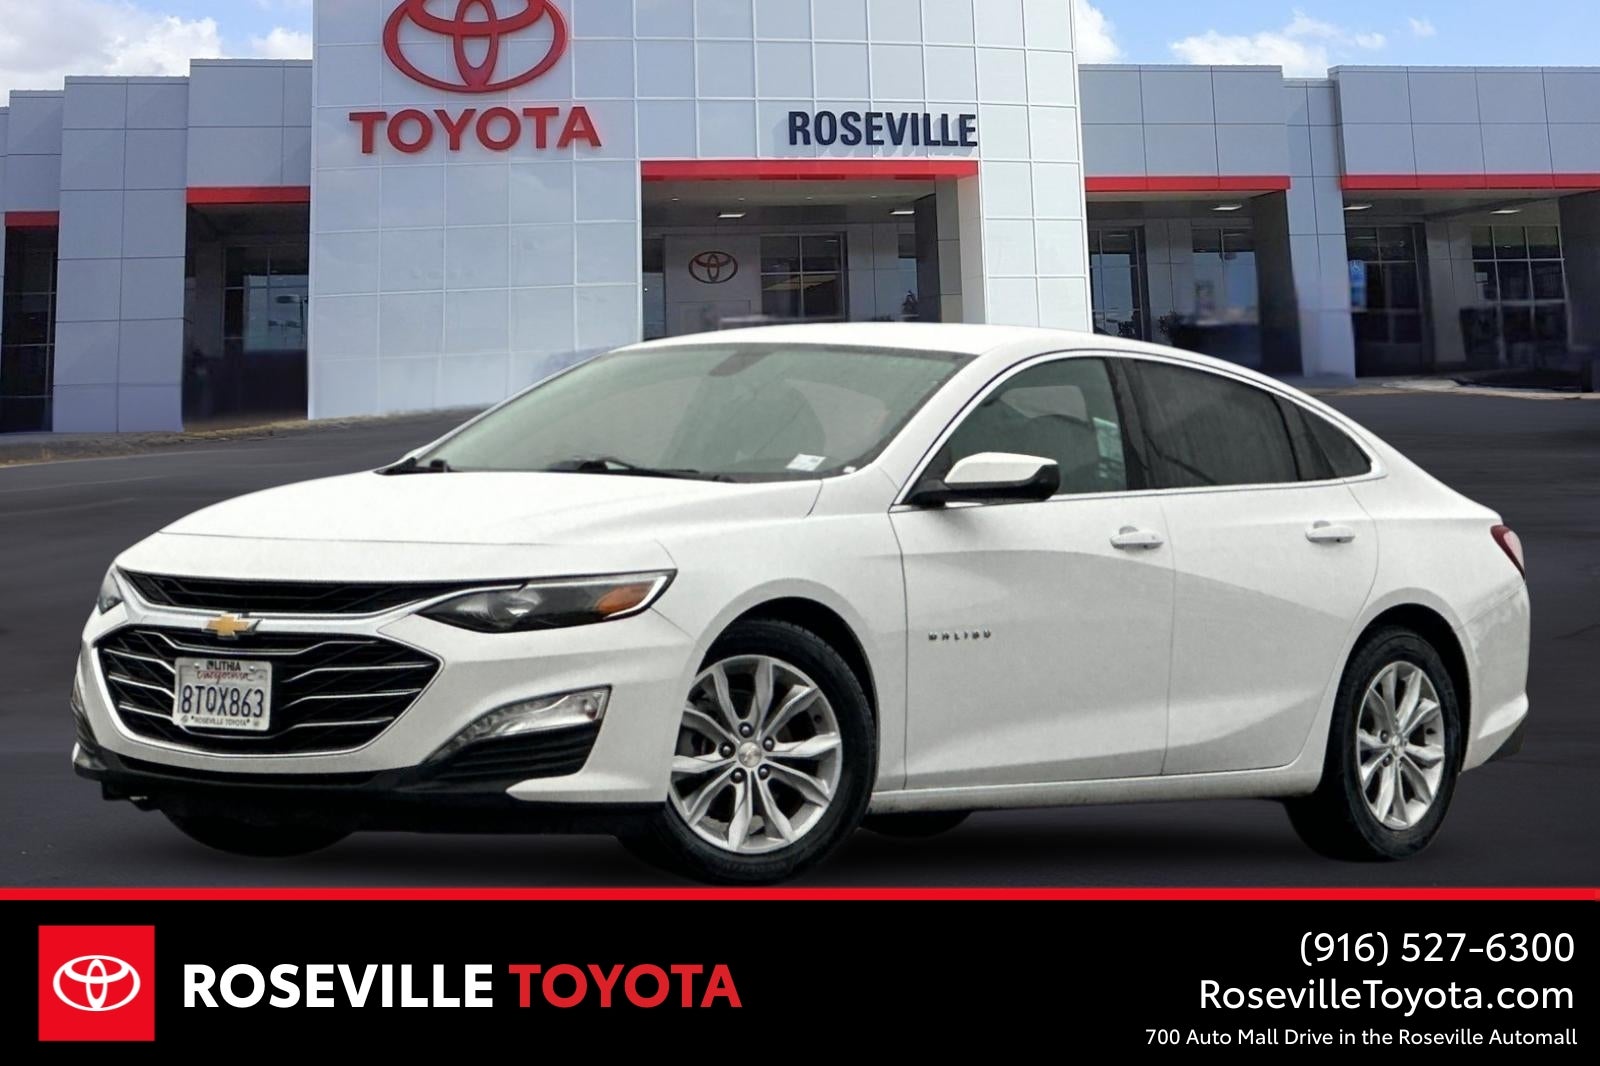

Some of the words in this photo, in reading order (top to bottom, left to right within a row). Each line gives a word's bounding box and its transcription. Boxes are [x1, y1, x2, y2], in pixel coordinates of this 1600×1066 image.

[350, 106, 602, 154] TOYOTA
[788, 111, 978, 147] ROSEVILLE
[214, 661, 241, 671] LITHIA
